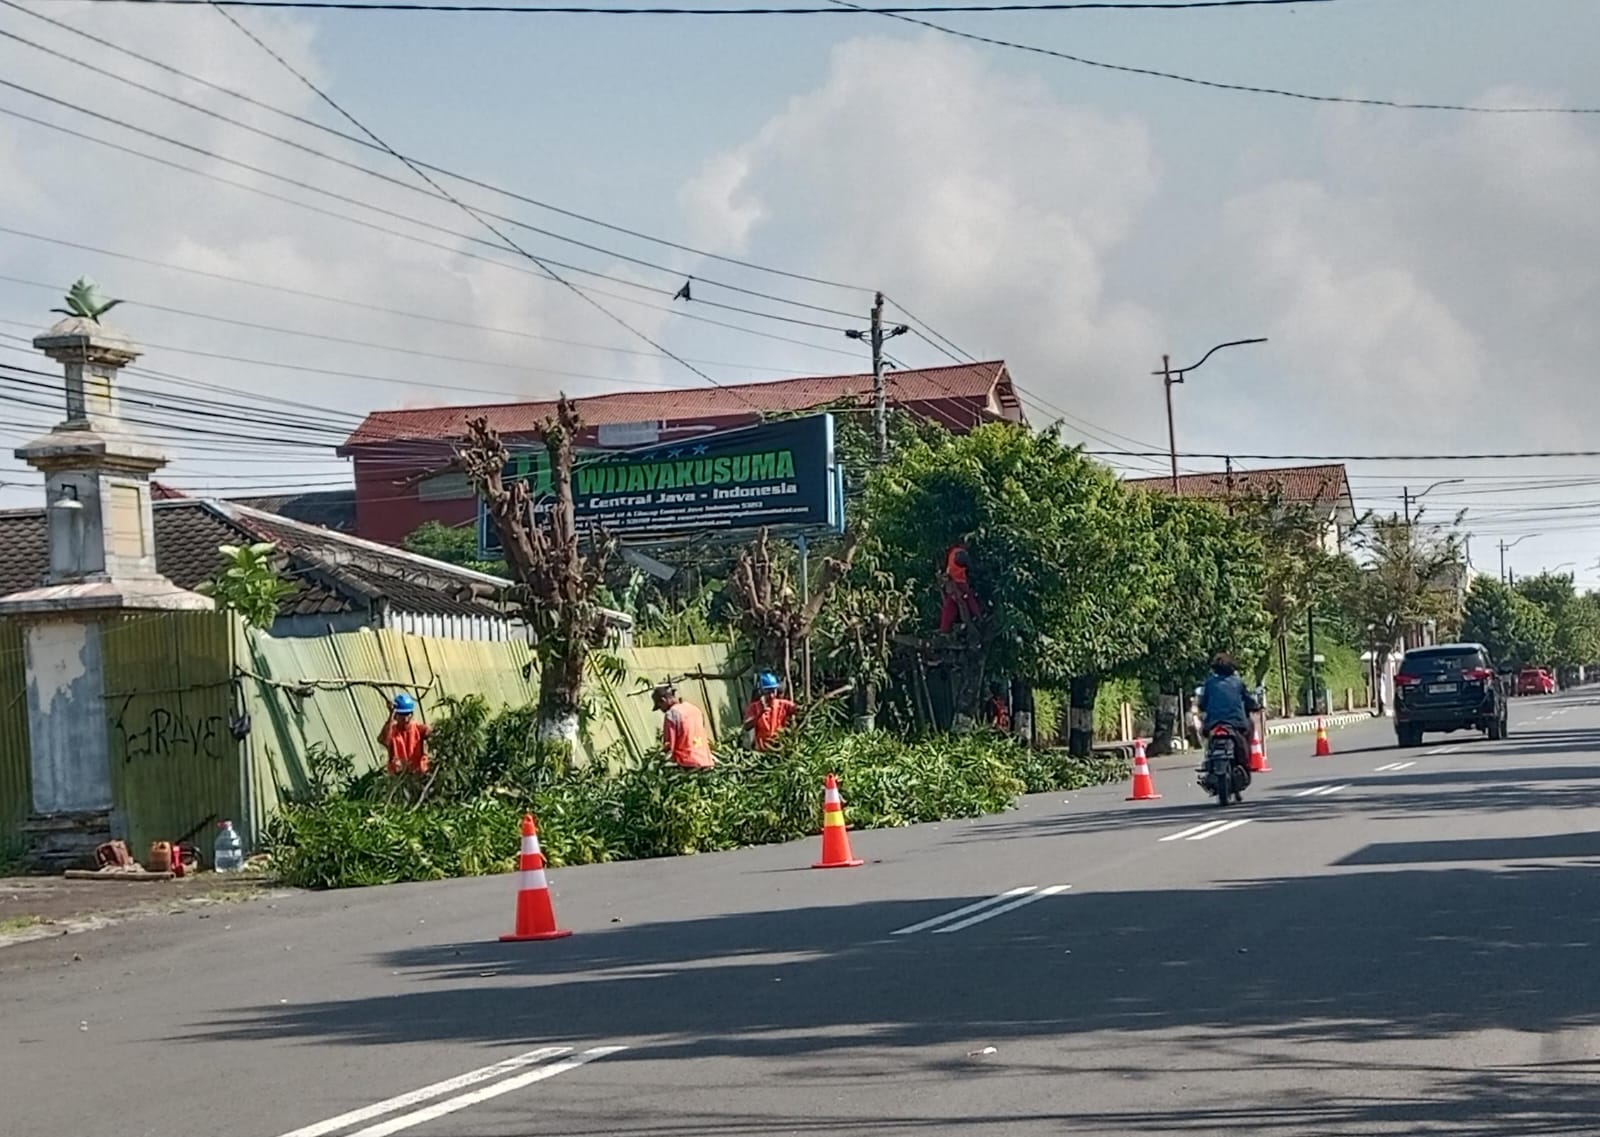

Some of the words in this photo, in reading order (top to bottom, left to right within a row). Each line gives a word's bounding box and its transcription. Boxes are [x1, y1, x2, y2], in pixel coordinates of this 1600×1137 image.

[578, 451, 795, 496] WIJAYAKUSUMA
[590, 494, 651, 509] Central
[656, 493, 696, 504] Java
[713, 482, 797, 499] Indonesia
